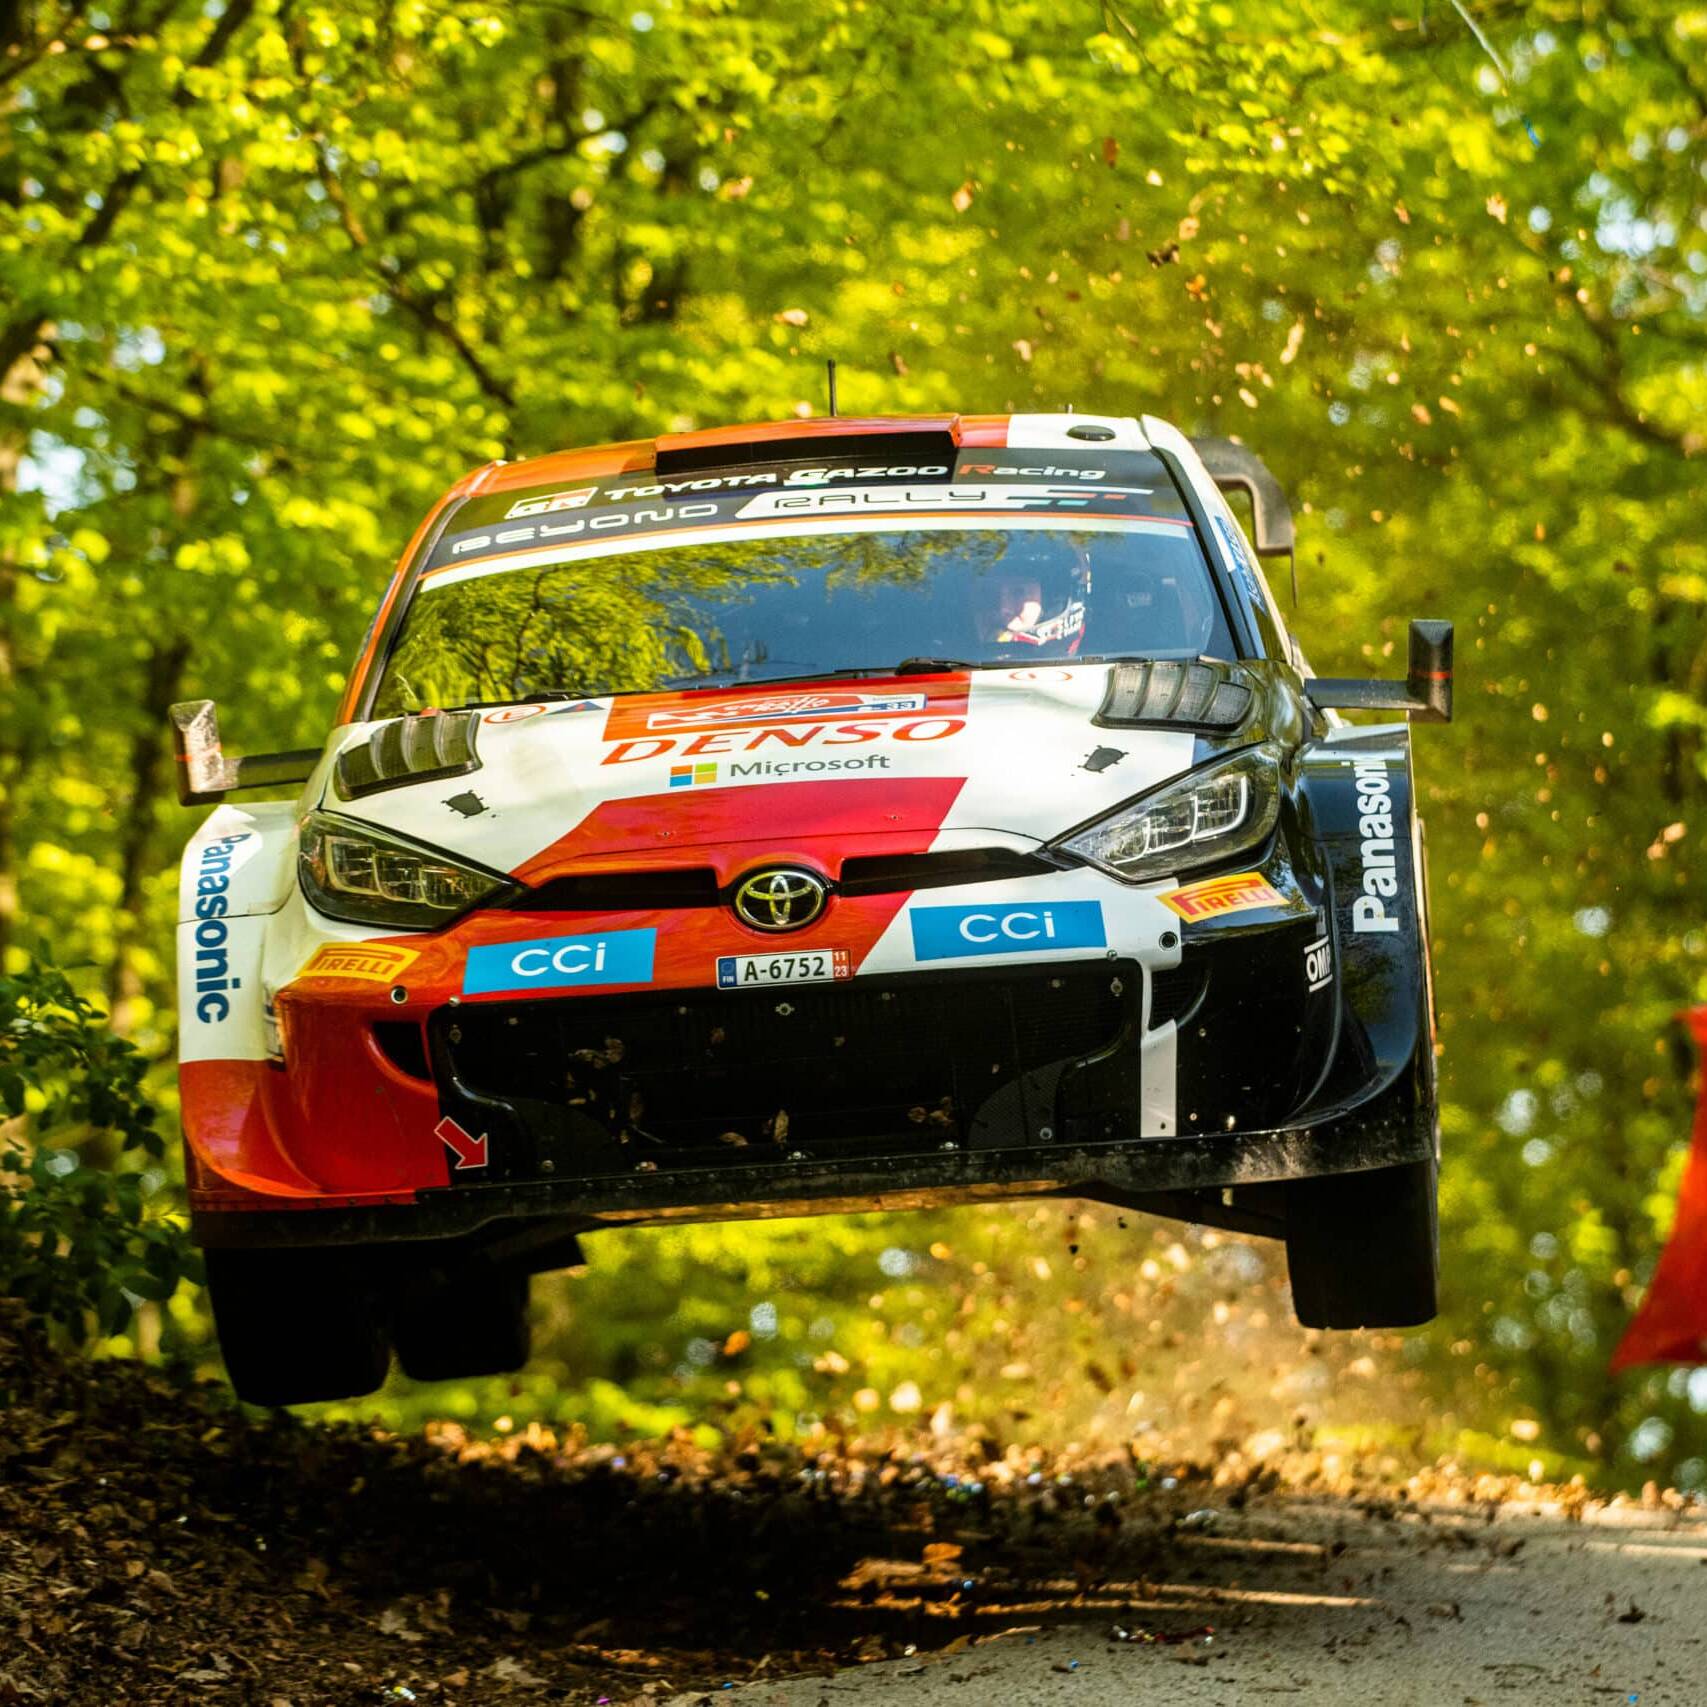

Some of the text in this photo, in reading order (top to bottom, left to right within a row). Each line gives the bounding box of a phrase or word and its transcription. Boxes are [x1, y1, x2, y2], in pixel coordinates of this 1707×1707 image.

[507, 463, 1107, 519] GR TOYOTA GAZOO Racing
[452, 490, 986, 555] BEYOND RALLY
[600, 719, 967, 766] DENSO
[730, 754, 891, 777] Microsoft
[1172, 879, 1276, 916] PIRELLI
[195, 832, 251, 1024] Panasonic
[303, 948, 406, 976] PIRELLI
[722, 956, 826, 984] FIN A-6752
[833, 951, 847, 961] 11
[834, 965, 848, 977] 23
[1306, 943, 1332, 982] OMP
